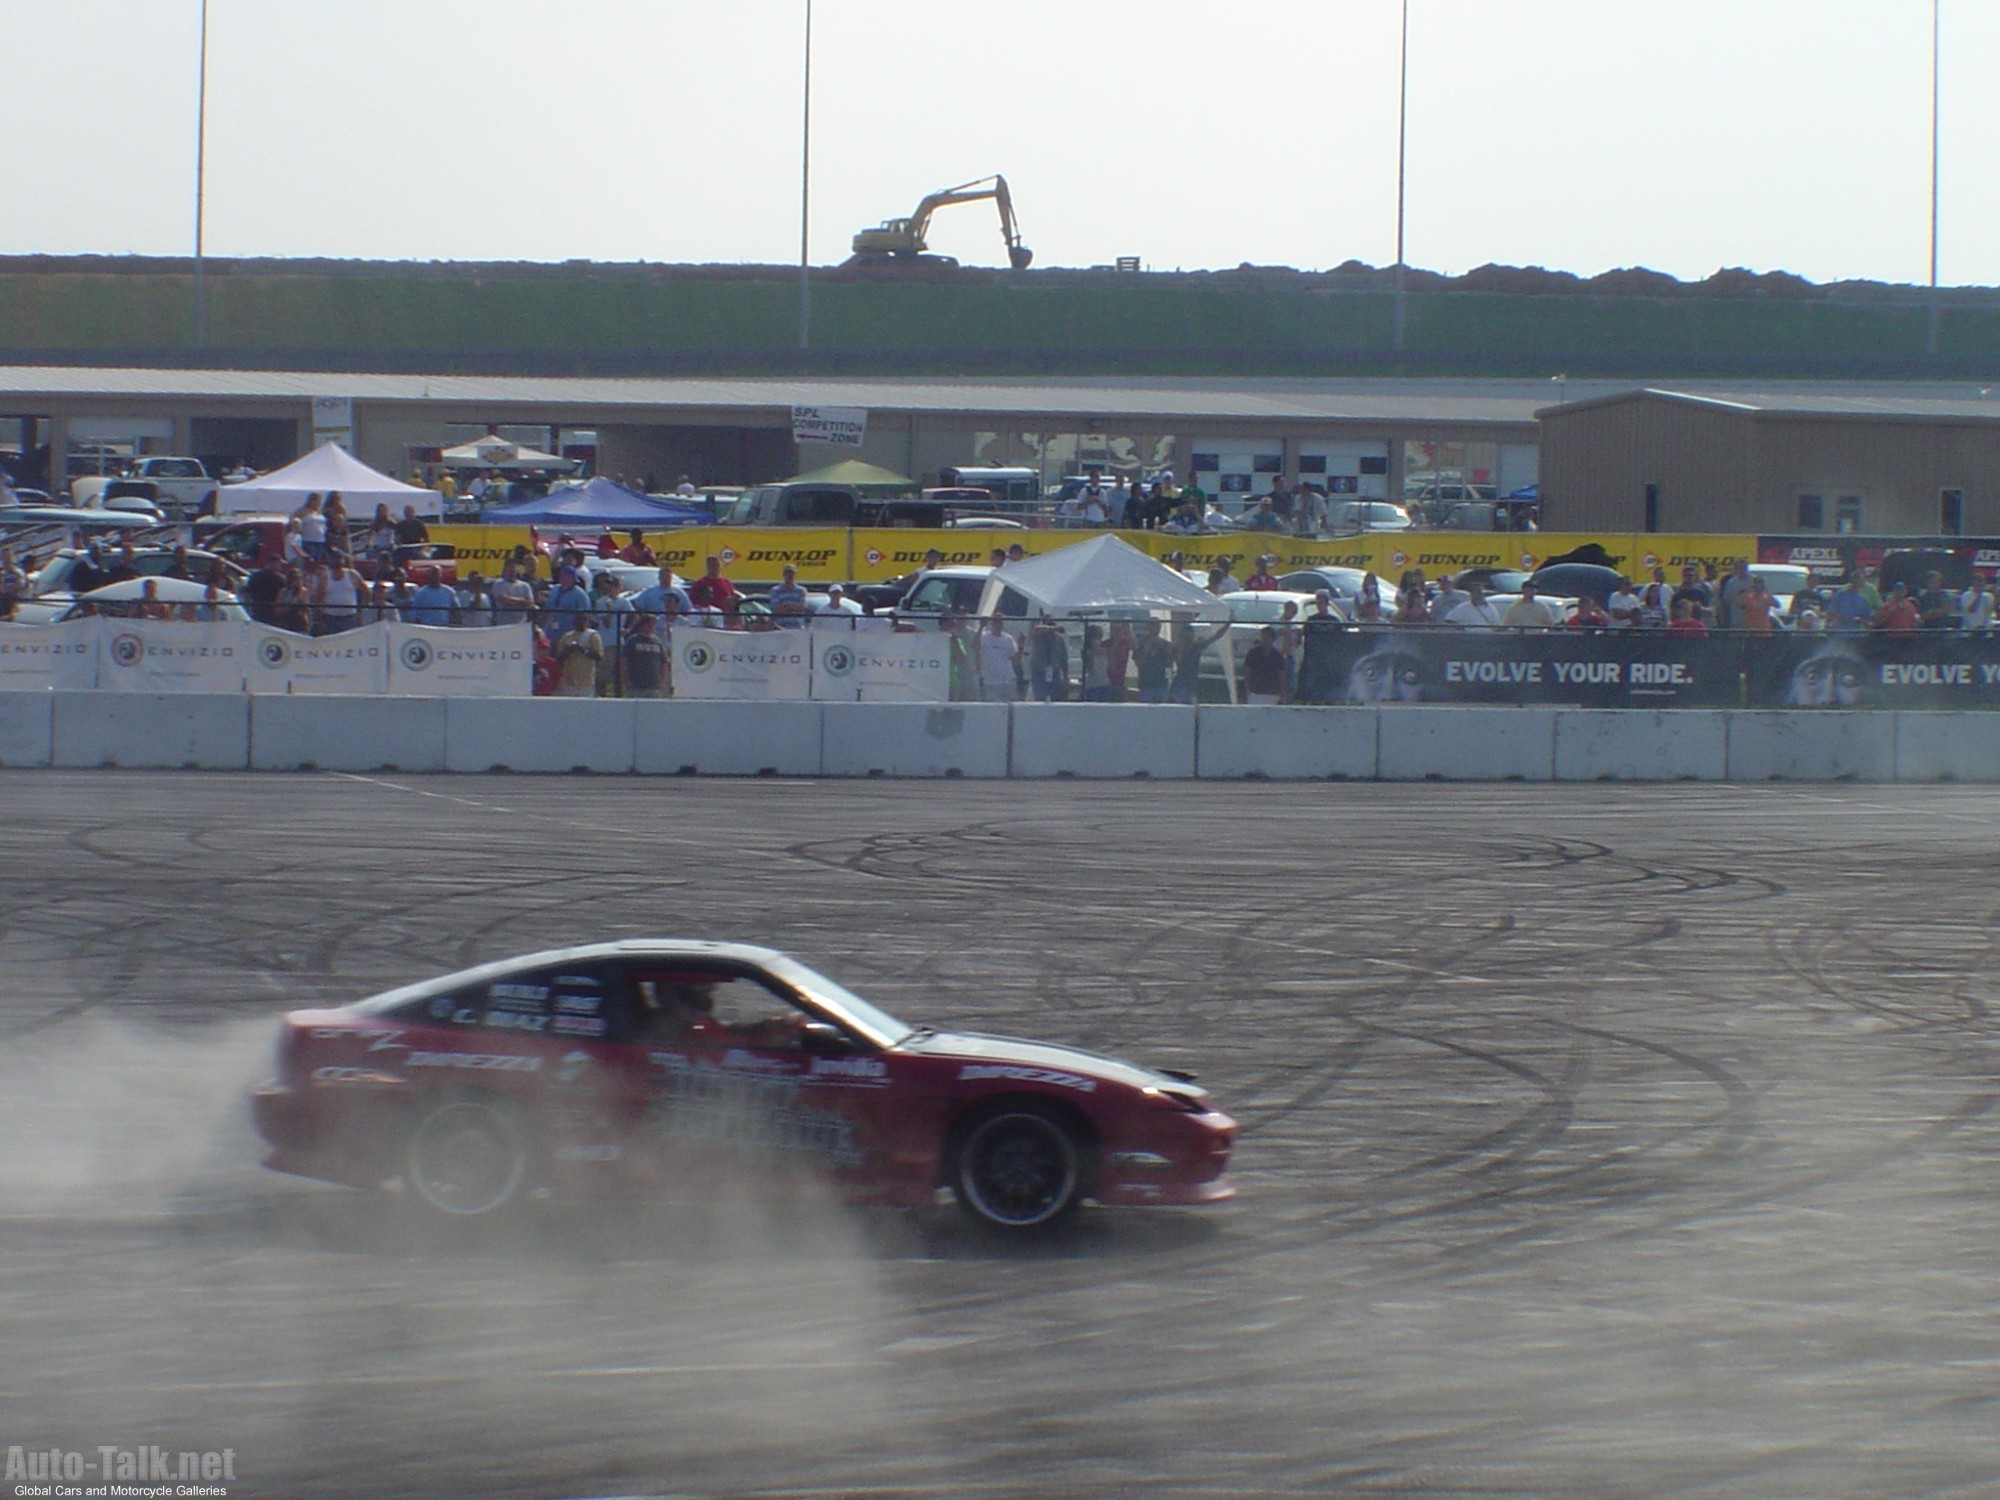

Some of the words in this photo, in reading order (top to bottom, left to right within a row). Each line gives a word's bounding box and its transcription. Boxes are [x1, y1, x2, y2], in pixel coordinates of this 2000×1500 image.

[794, 407, 820, 418] SPL
[794, 419, 863, 432] COMPETITION
[830, 432, 860, 444] ZONE
[746, 550, 837, 561] DUNLOP
[892, 551, 981, 563] DULOP
[1288, 555, 1372, 566] DUNLOP
[1417, 554, 1501, 564] DUNLOP
[1, 644, 87, 654] ENVIZIO
[150, 647, 233, 657] ENVIZIO
[295, 647, 379, 659] ENVIZIO
[437, 650, 522, 660] ENVIZIO
[719, 653, 801, 664] ENVIZIO
[859, 658, 940, 669] ENVIZIO
[1446, 661, 1542, 682] EVOLVE
[1554, 662, 1620, 683] YOUR
[1630, 663, 1693, 684] RIDE.
[1881, 664, 1972, 684] EVOLVE
